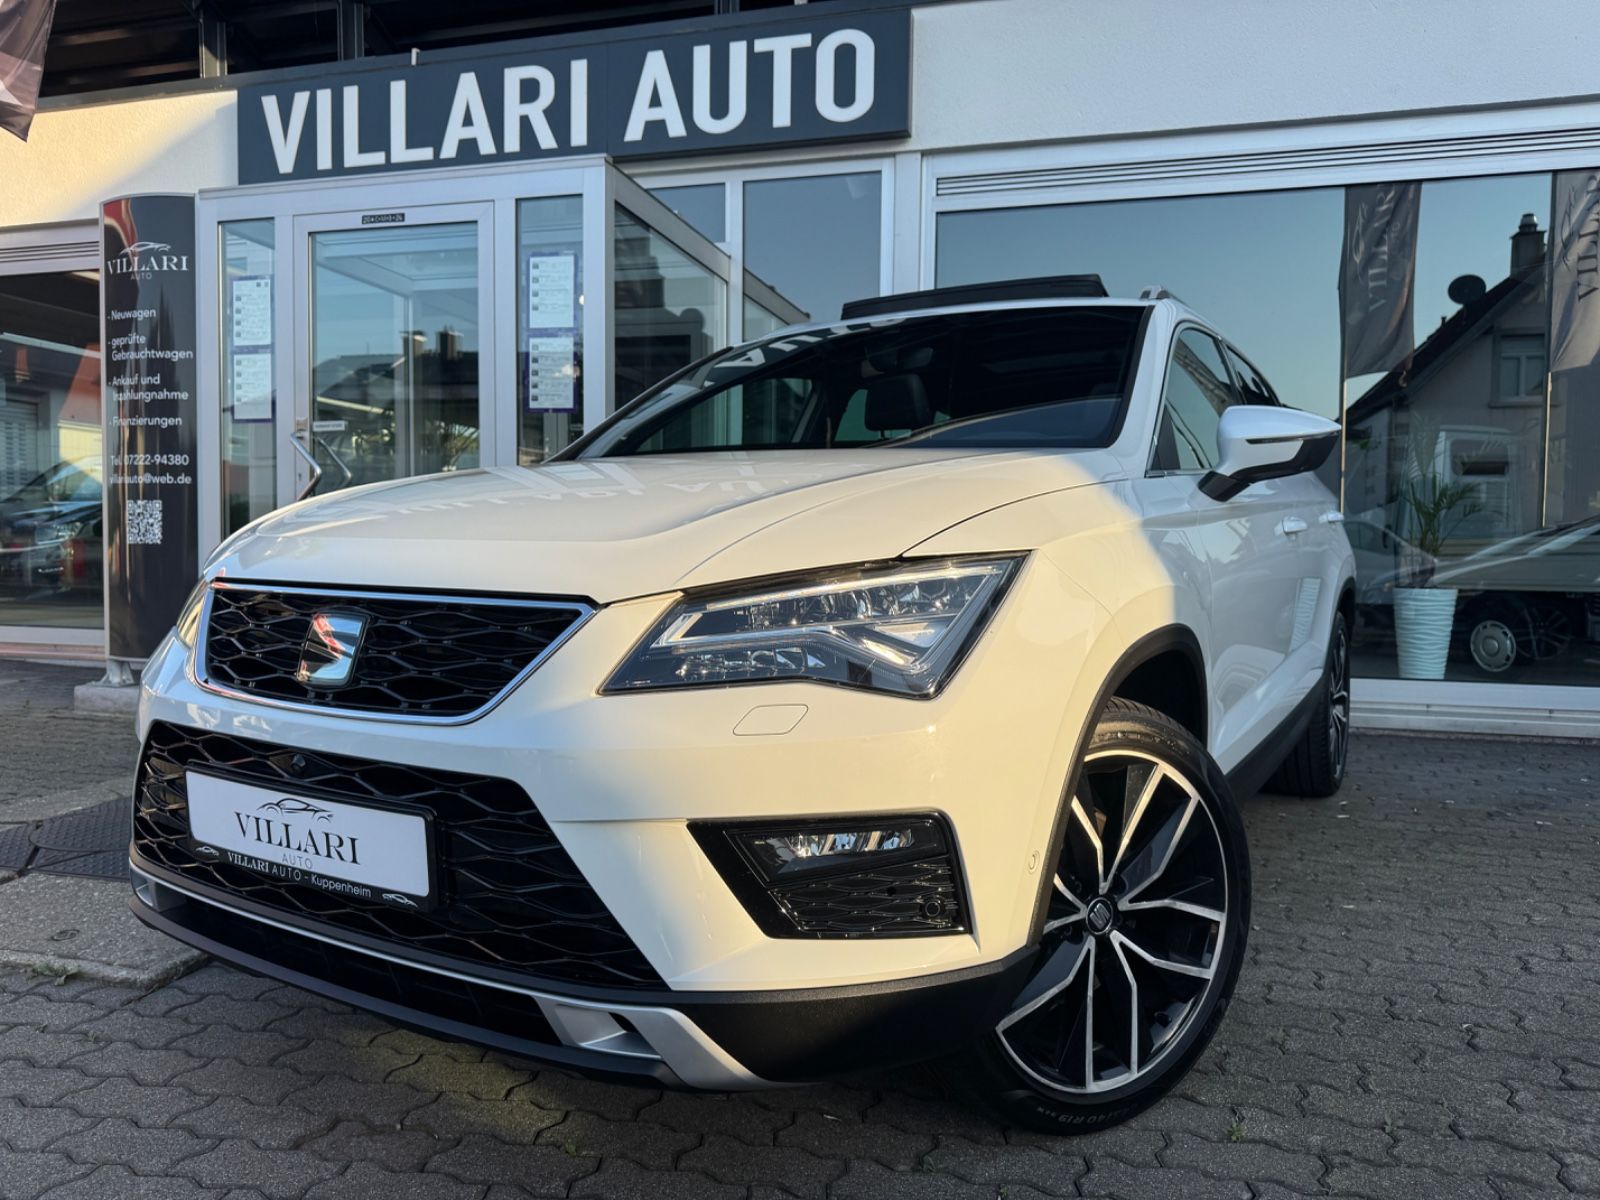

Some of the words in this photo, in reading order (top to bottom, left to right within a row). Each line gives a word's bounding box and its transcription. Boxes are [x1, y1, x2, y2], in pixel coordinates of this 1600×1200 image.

[261, 58, 588, 174] VILLARI
[623, 28, 876, 142] AUTO
[107, 255, 189, 275] VILLARI
[111, 309, 156, 320] Neuwagen
[111, 333, 146, 349] geprüfte
[112, 347, 194, 362] Gebrauchtwagen
[112, 374, 138, 386] Ankauf
[141, 373, 160, 385] und
[112, 415, 182, 428] Finanzierungen
[234, 811, 361, 865] VILLARI
[281, 853, 313, 870] AUTO
[227, 851, 270, 872] VILLARI
[271, 865, 302, 881] AUTO
[311, 874, 372, 898] Kuppenheim
